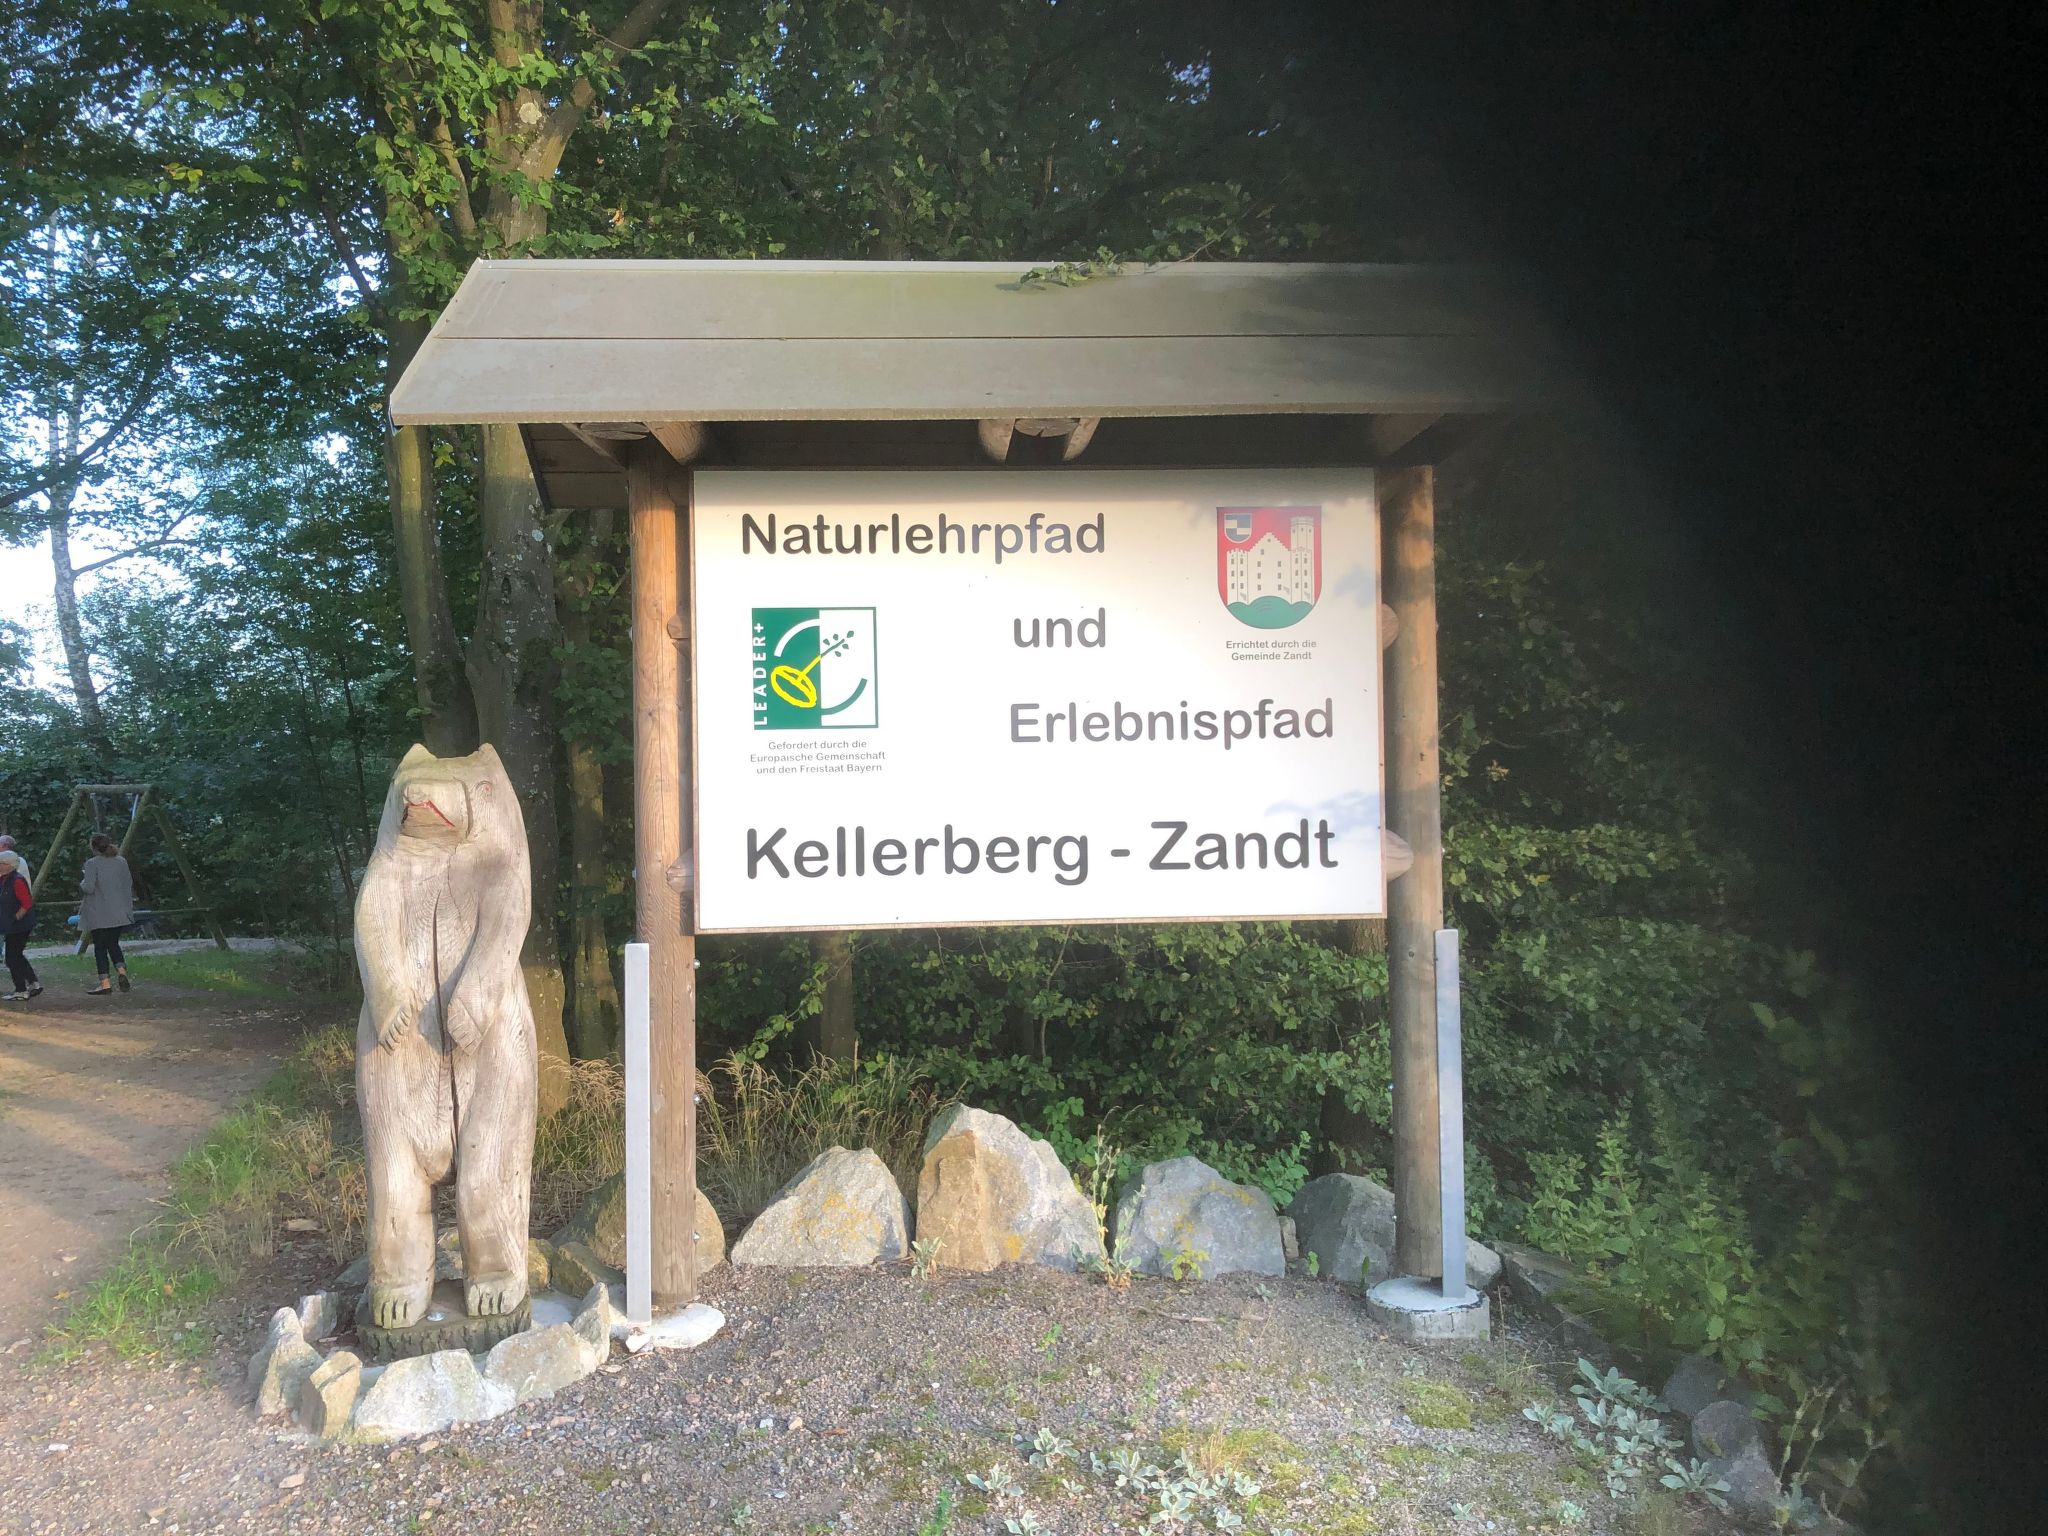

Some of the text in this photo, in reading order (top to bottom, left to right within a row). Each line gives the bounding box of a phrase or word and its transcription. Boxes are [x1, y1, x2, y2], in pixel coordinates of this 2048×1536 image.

[741, 512, 1106, 564] Naturlehrpfad
[1013, 608, 1107, 648] und
[1225, 639, 1317, 649] Errichtet durch die
[1231, 651, 1312, 661] Gemeinde Zandt
[752, 622, 768, 726] LEADER+
[1010, 698, 1335, 750] Erlebnispfad
[816, 751, 886, 762] Gemeinschaft
[820, 740, 849, 750] durch
[851, 740, 867, 749] die
[756, 763, 883, 775] und den Freistaat Bayern
[746, 824, 1090, 886] Kellerberg
[1149, 819, 1339, 871] Zandt
